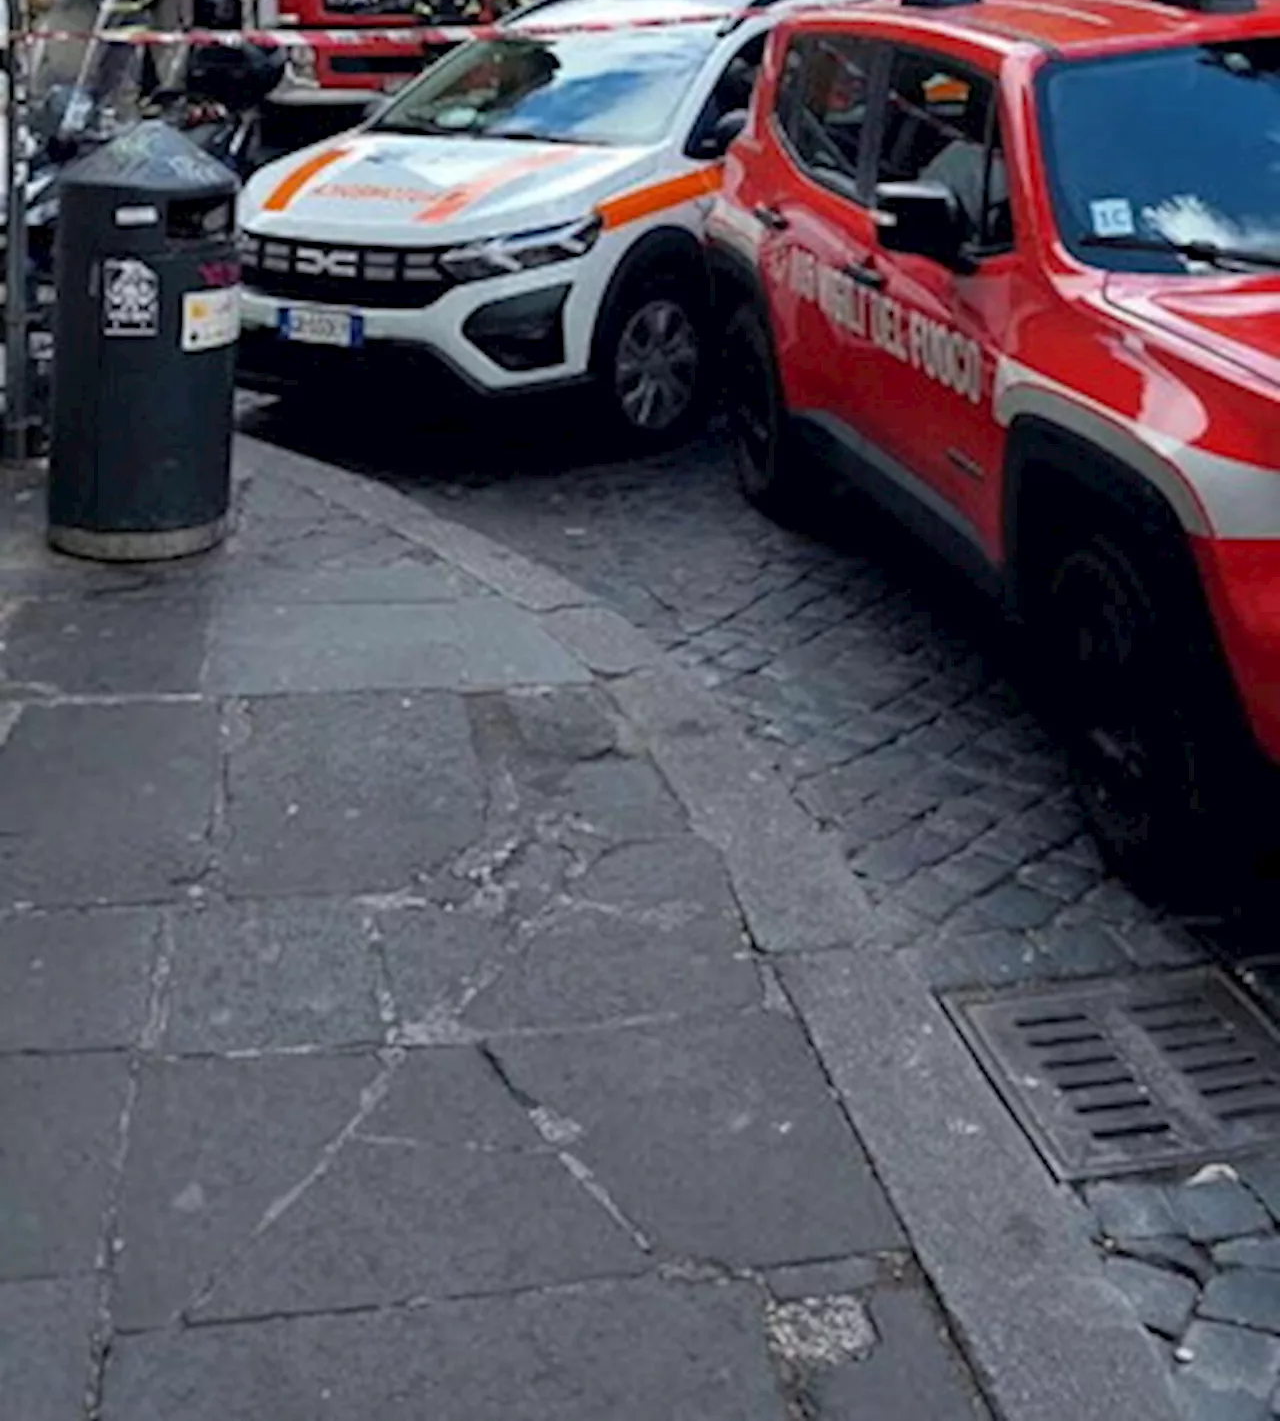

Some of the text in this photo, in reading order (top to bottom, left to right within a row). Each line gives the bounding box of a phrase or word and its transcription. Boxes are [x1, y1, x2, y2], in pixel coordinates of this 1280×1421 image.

[816, 262, 867, 337] VIGILI
[867, 287, 908, 362] DEL
[909, 309, 982, 405] FUOCO
